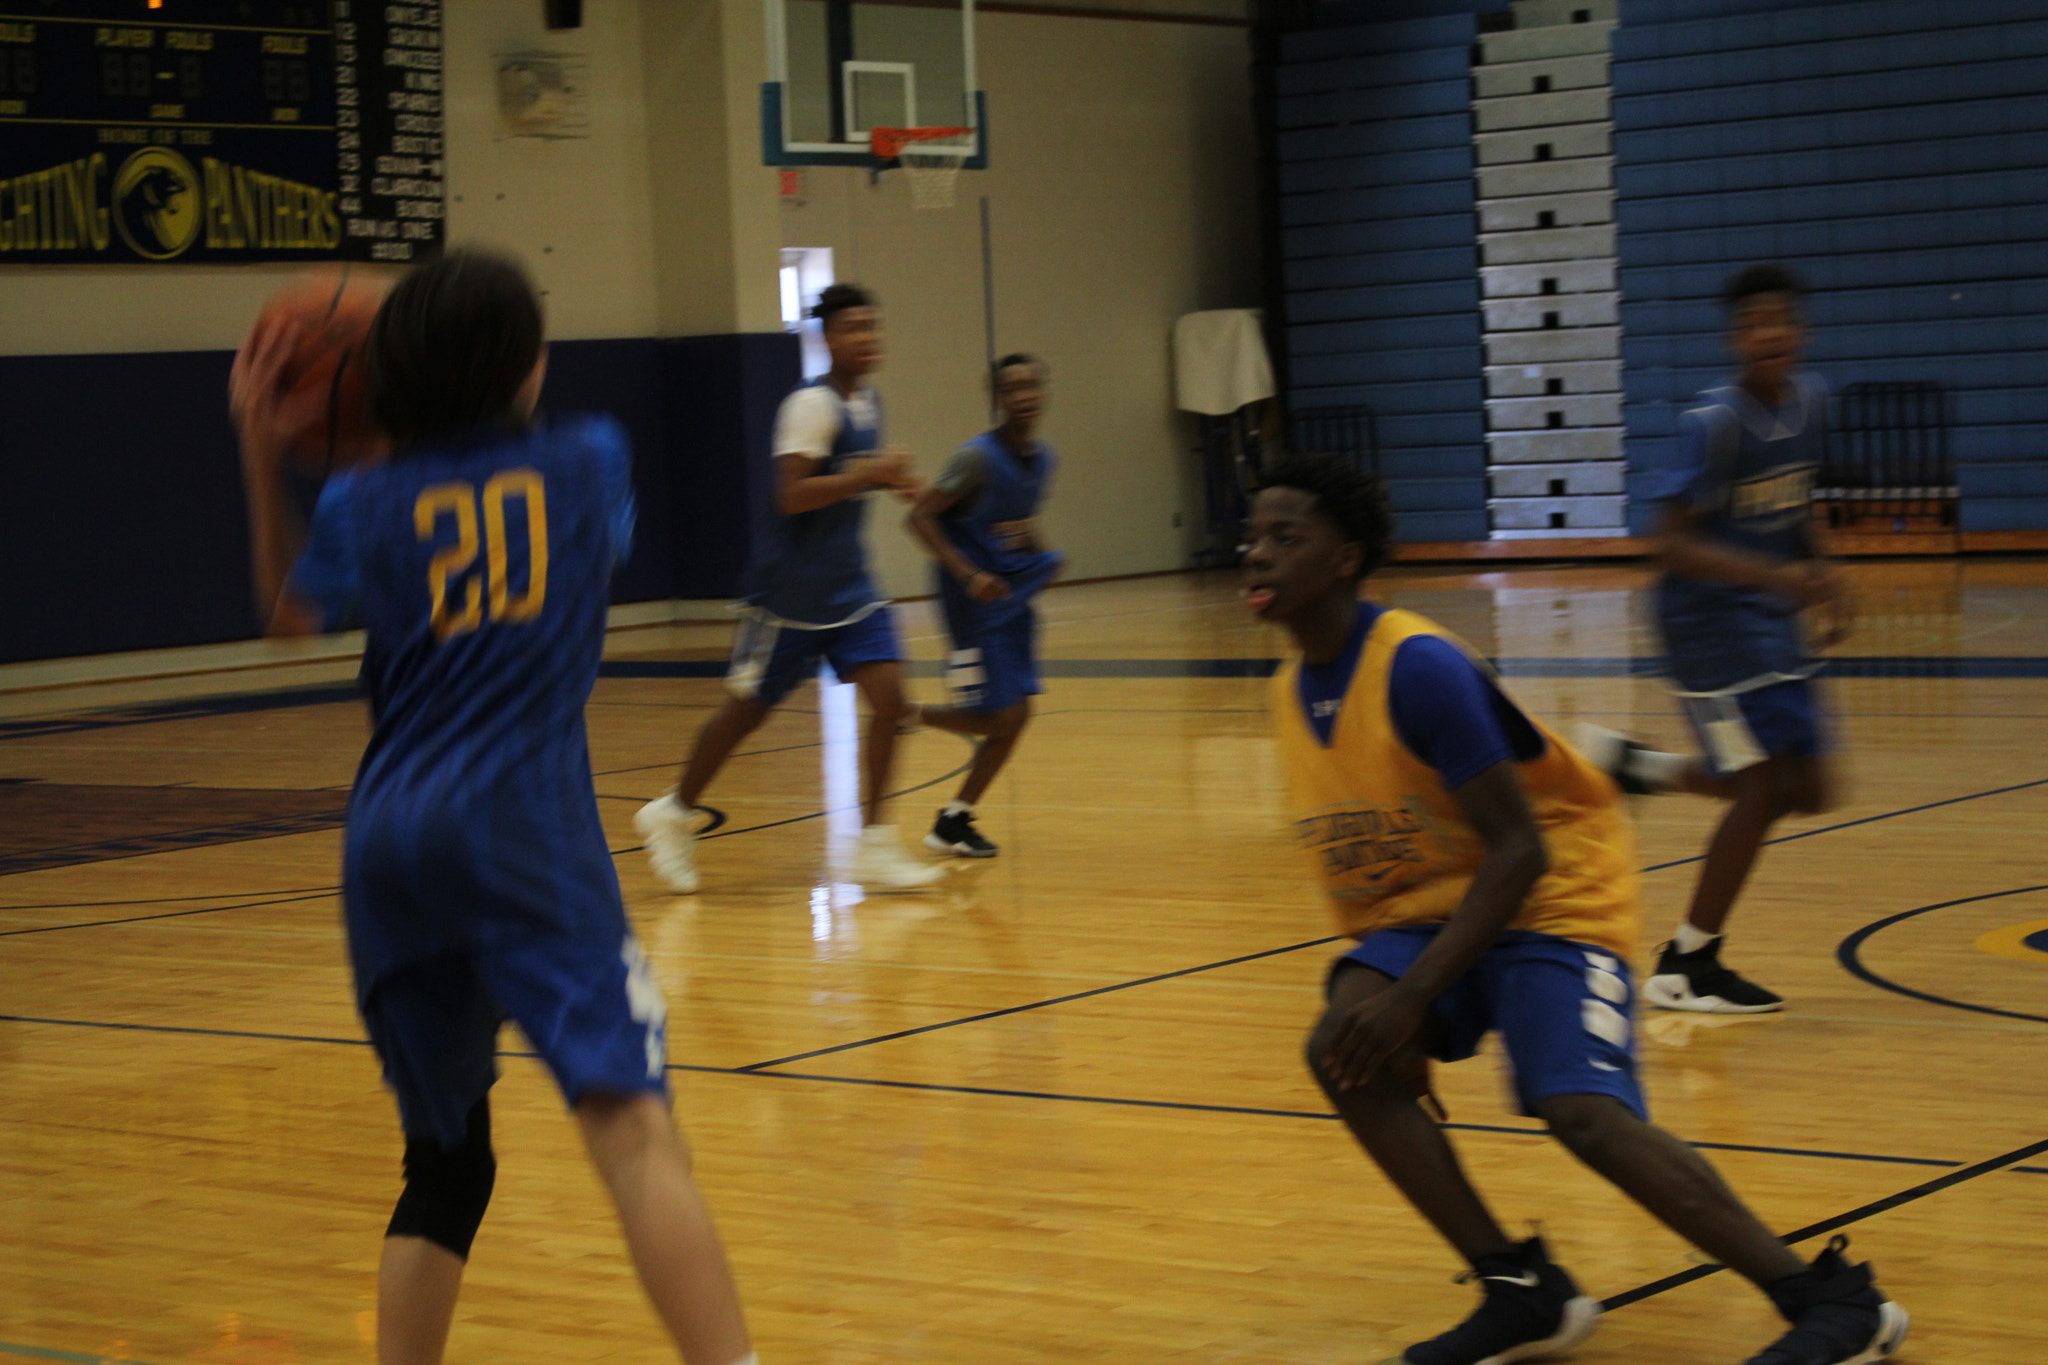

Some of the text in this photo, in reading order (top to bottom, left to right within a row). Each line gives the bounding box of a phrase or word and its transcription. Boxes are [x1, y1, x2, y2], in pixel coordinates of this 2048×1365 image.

[95, 27, 215, 51] PLAYER FOULS
[261, 35, 308, 55] FOULS
[97, 129, 214, 145] HOME OF THE
[202, 156, 340, 250] PANTHERS
[414, 467, 547, 643] 20
